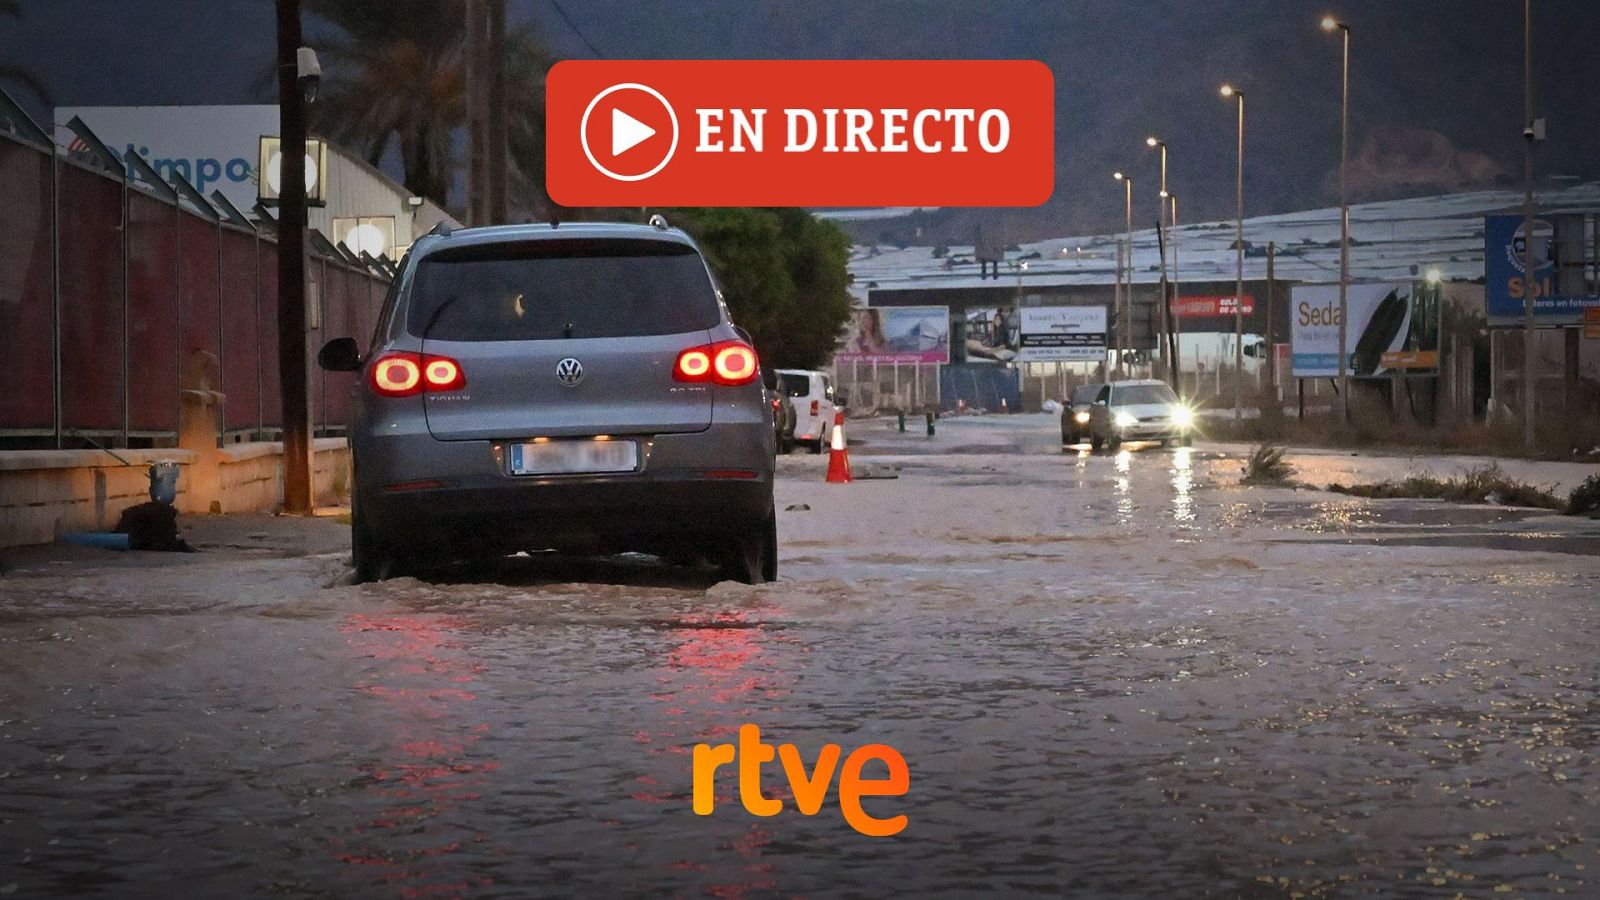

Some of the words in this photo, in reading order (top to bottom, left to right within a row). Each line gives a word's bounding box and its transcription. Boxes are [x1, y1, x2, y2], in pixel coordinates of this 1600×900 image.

[107, 143, 250, 192] lmpo
[1299, 301, 1341, 326] Seda
[1522, 299, 1555, 308] Leres
